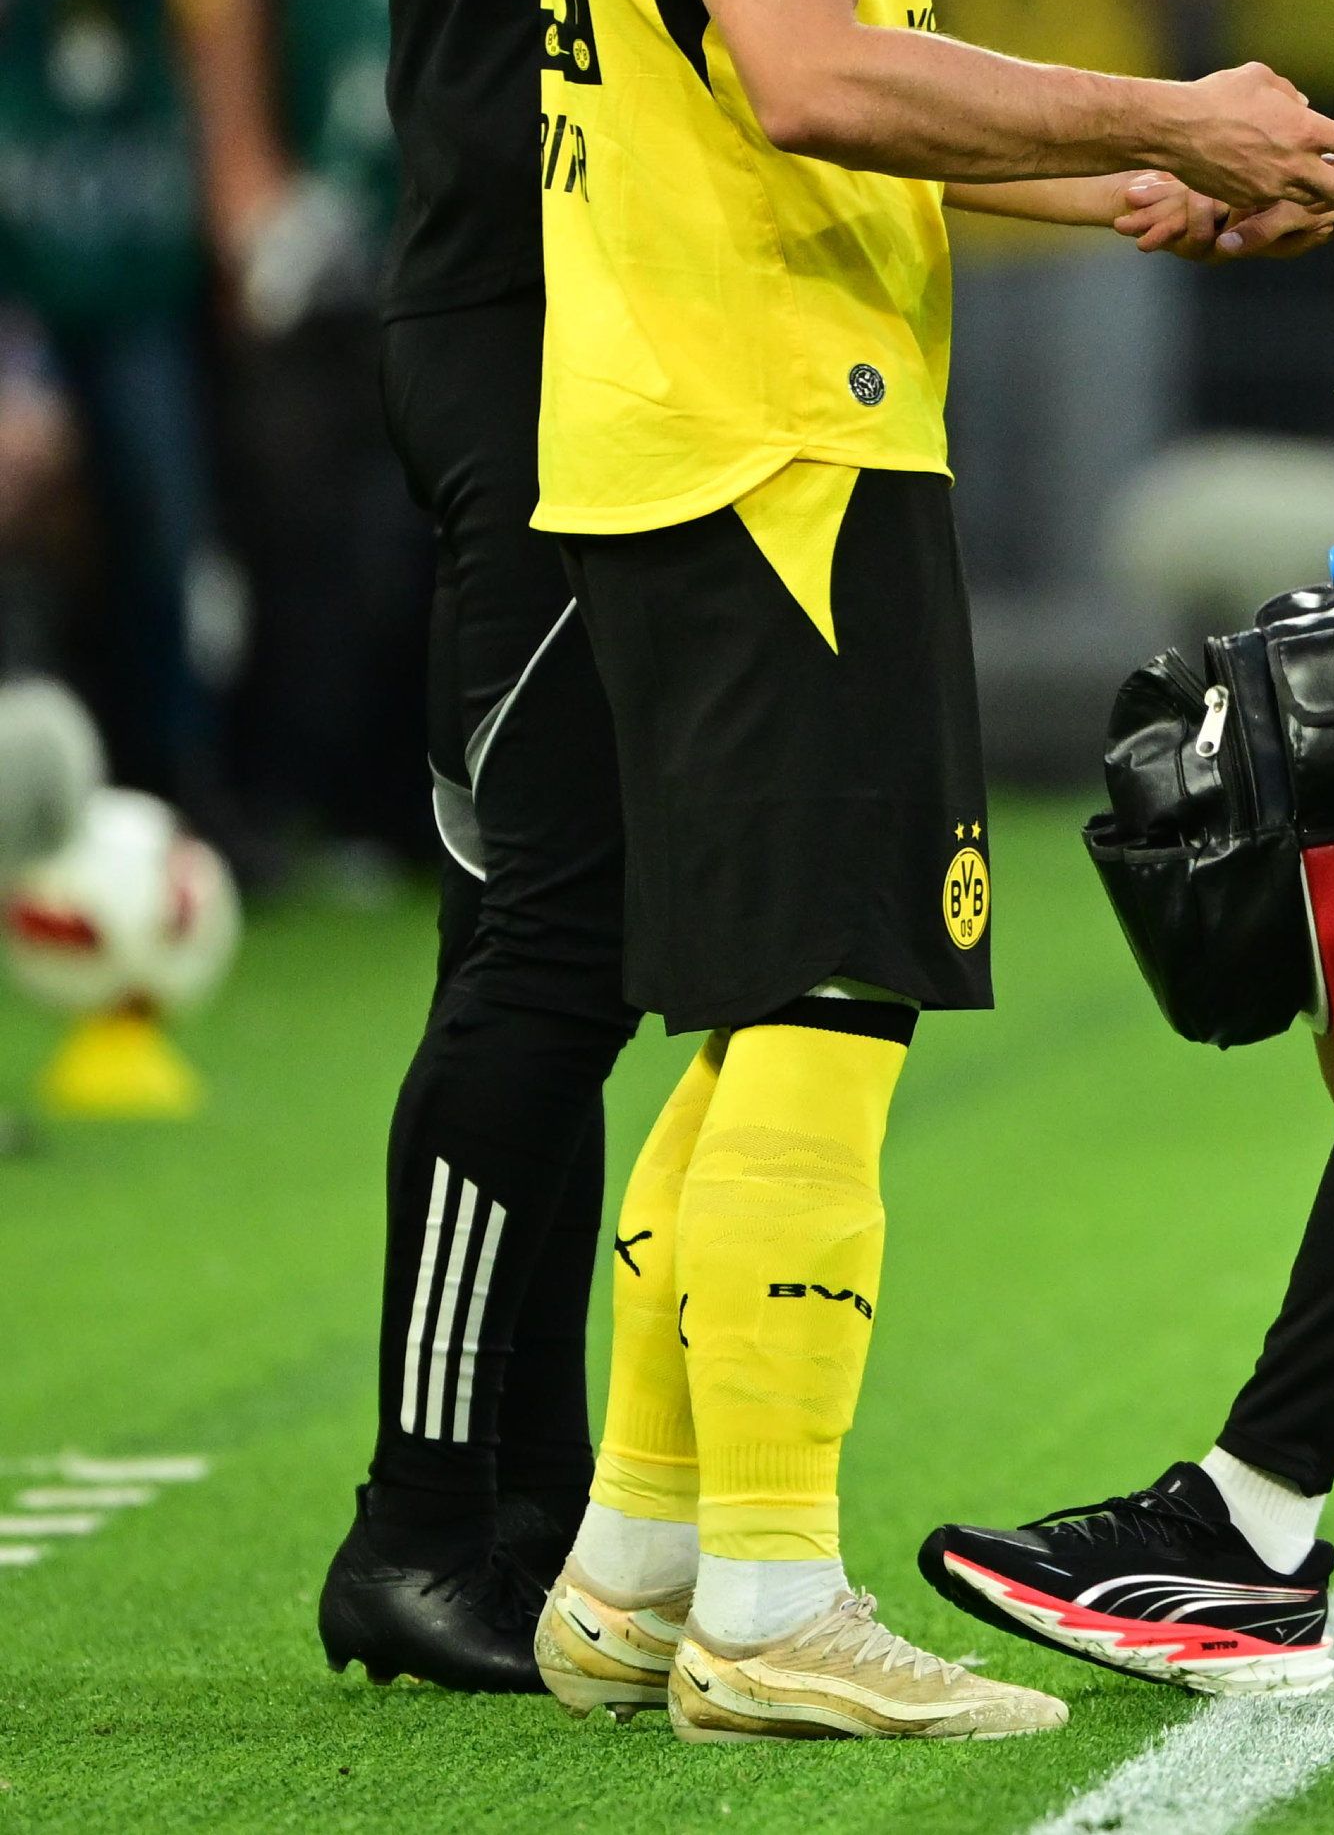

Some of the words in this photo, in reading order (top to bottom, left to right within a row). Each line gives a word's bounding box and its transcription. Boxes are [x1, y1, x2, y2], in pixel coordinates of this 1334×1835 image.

[951, 859, 984, 918] BVB
[960, 918, 973, 938] 09
[768, 1283, 872, 1320] BVB
